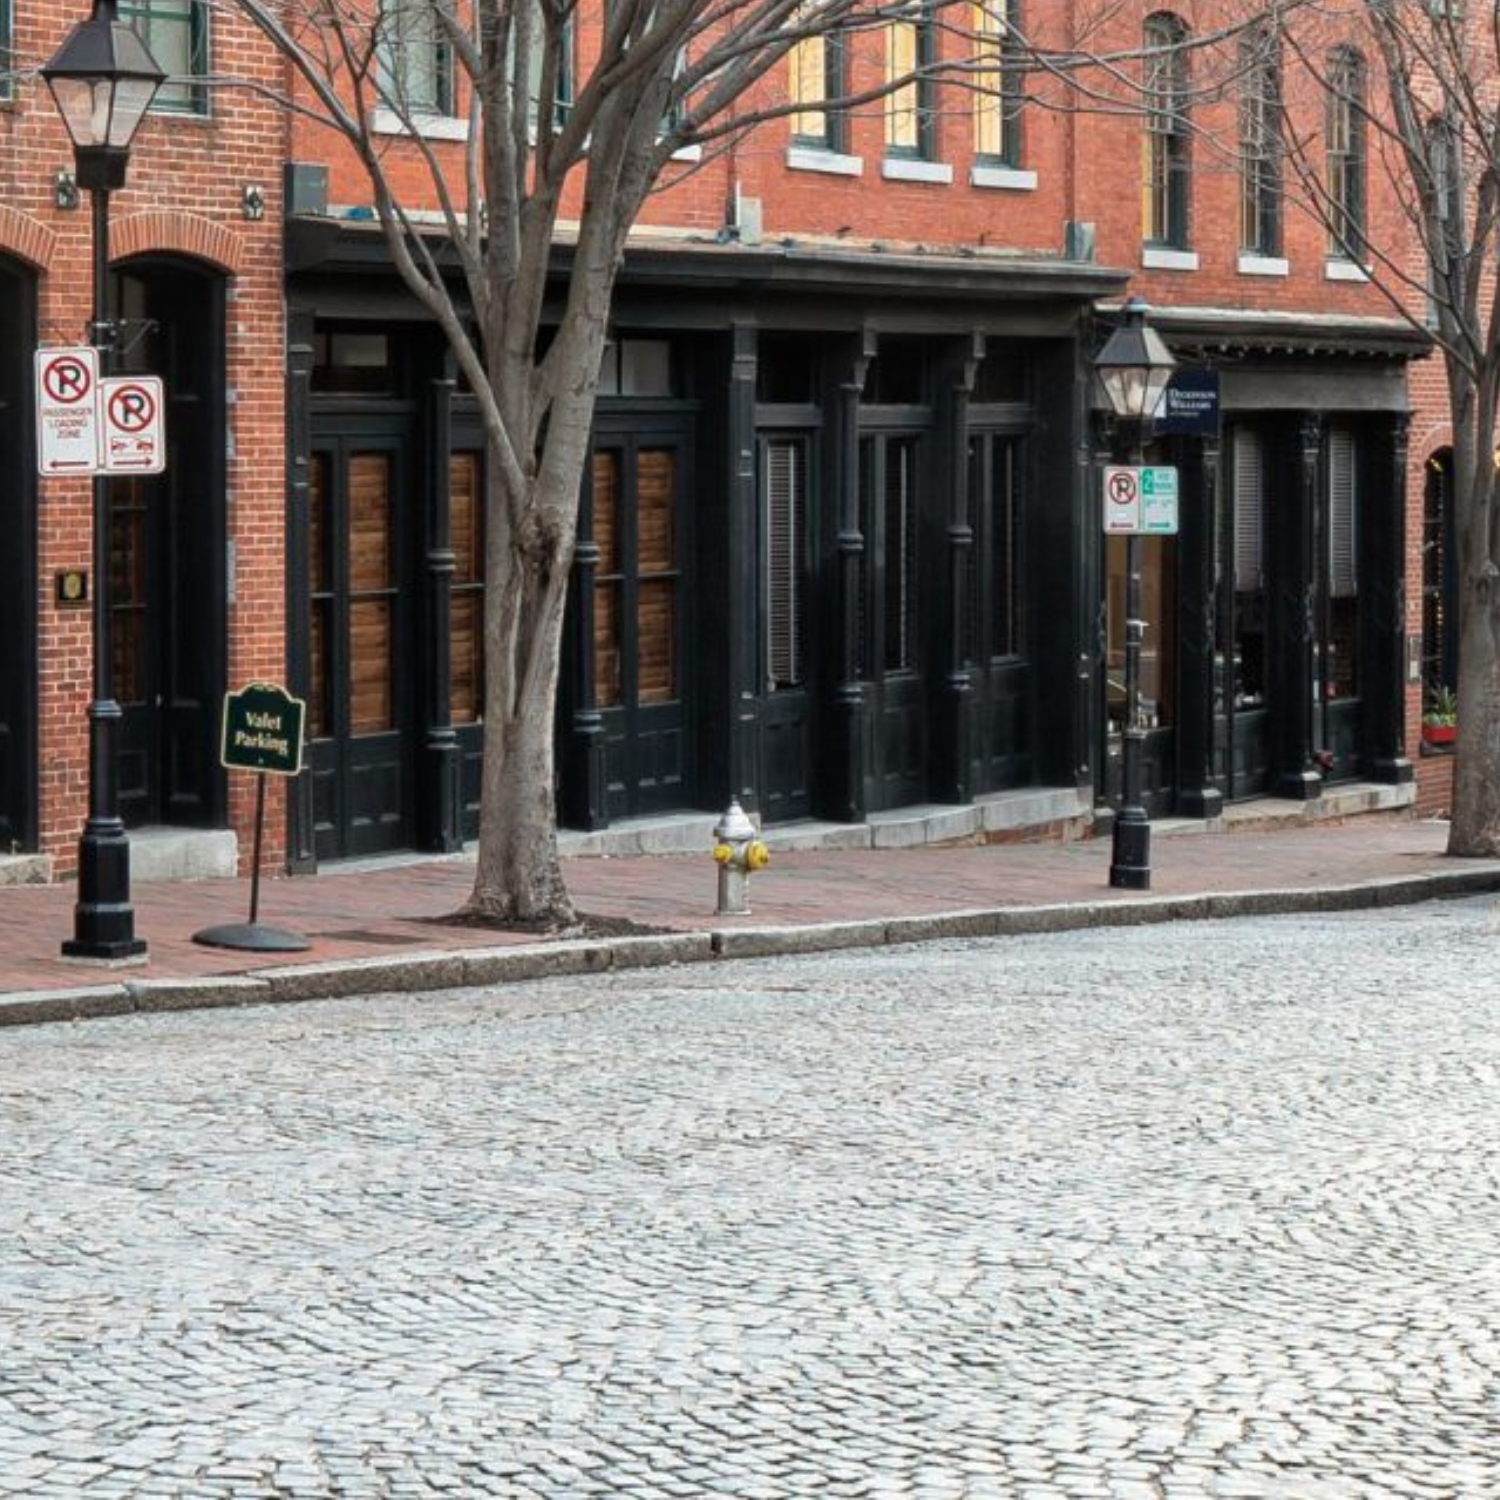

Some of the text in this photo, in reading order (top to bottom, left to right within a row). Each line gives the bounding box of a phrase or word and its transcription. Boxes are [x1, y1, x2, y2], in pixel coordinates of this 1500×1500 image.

[41, 406, 93, 417] PASSENGER
[48, 418, 89, 429] LOADING
[56, 429, 81, 440] ZONE
[245, 711, 282, 731] Valet
[234, 730, 289, 756] Parking
